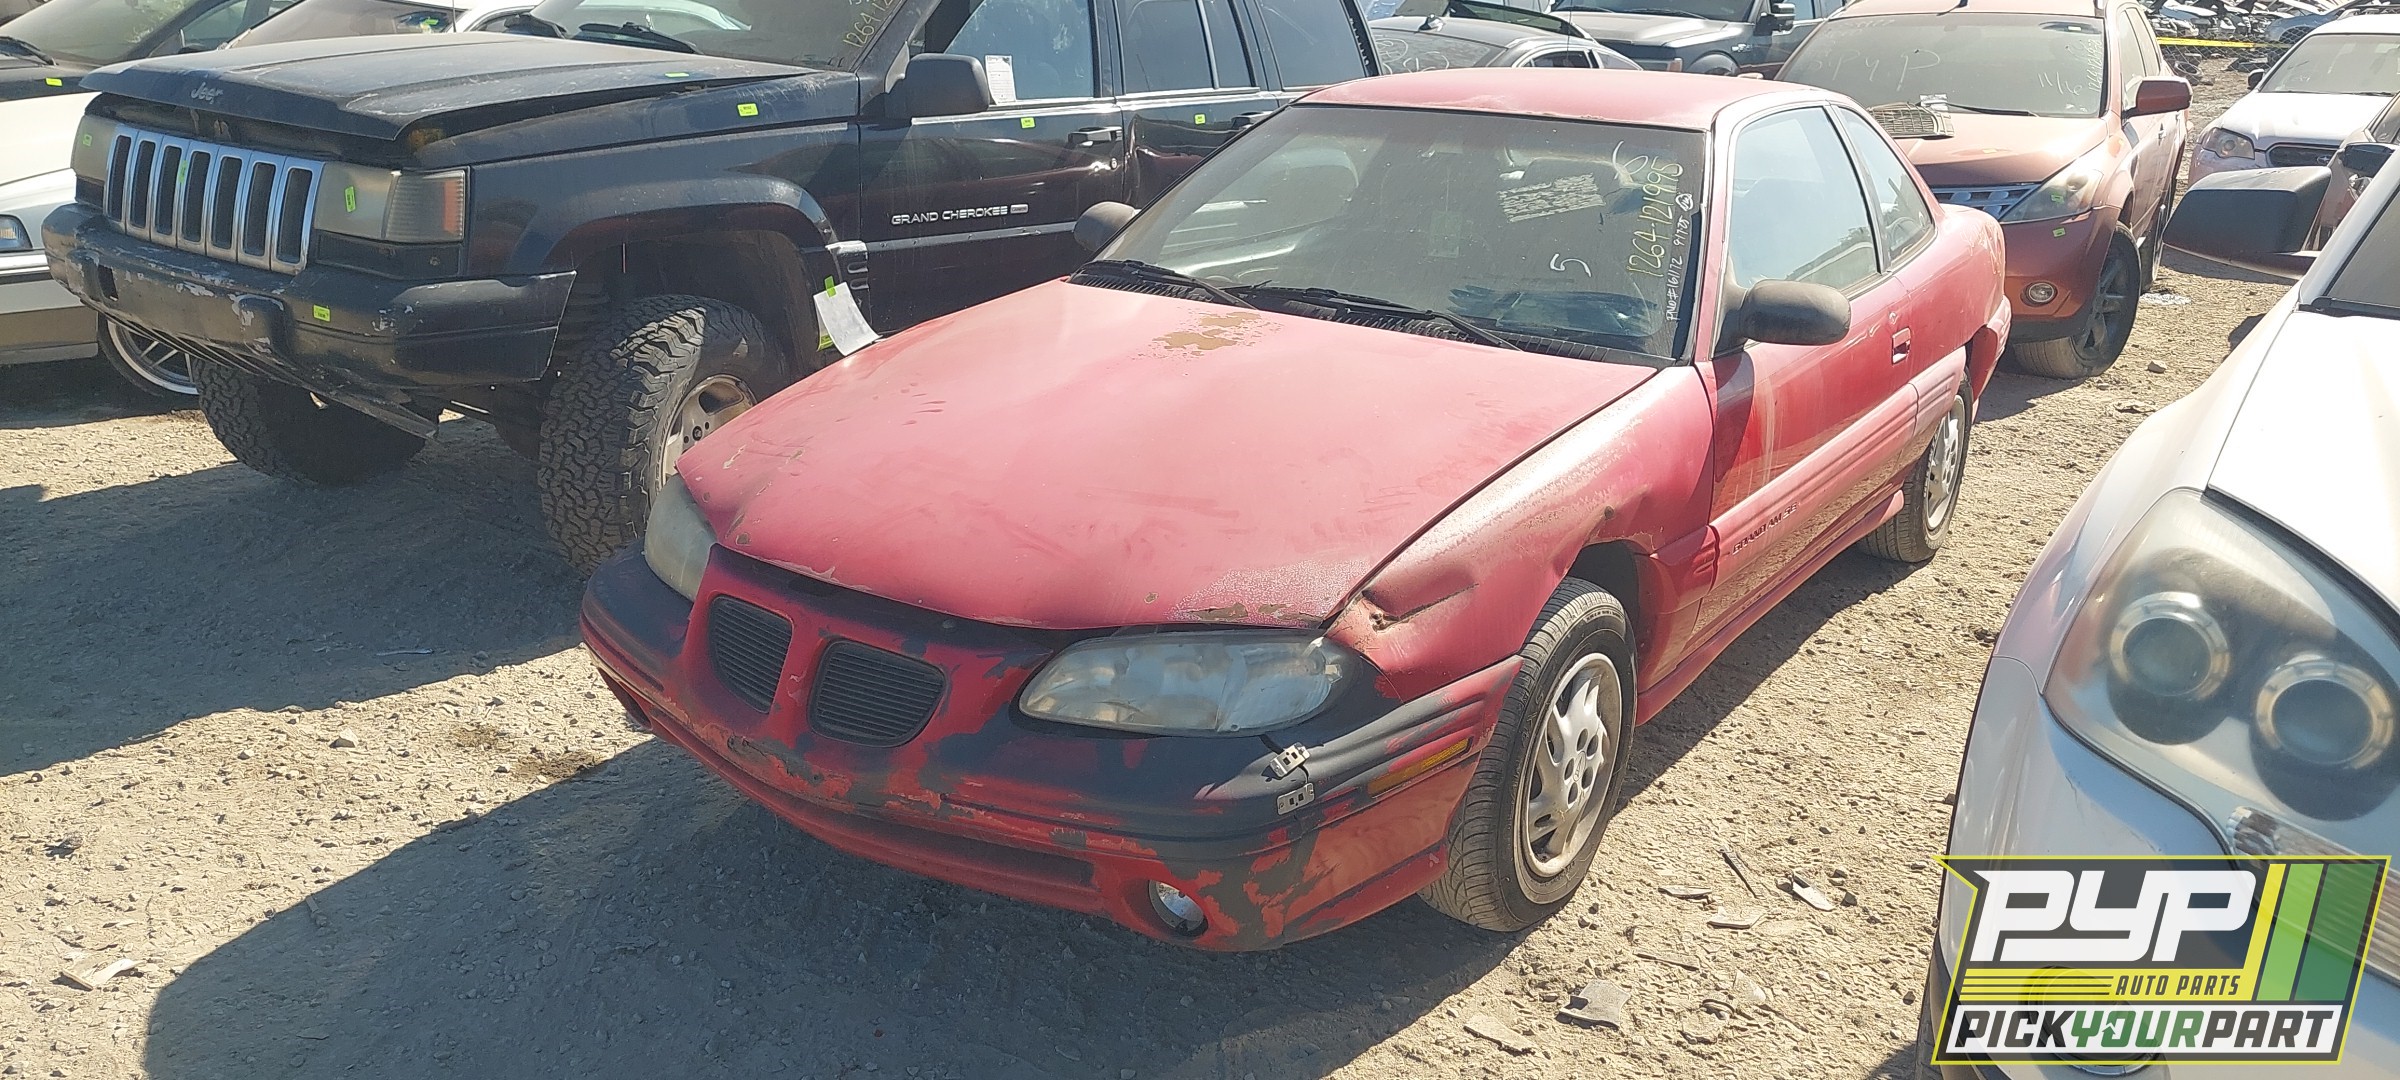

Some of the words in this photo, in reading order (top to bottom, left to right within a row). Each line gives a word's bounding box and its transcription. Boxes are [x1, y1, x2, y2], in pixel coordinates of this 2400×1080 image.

[190, 81, 224, 105] Jeep
[891, 211, 939, 225] GRAND
[941, 205, 1008, 220] CHEROKEE
